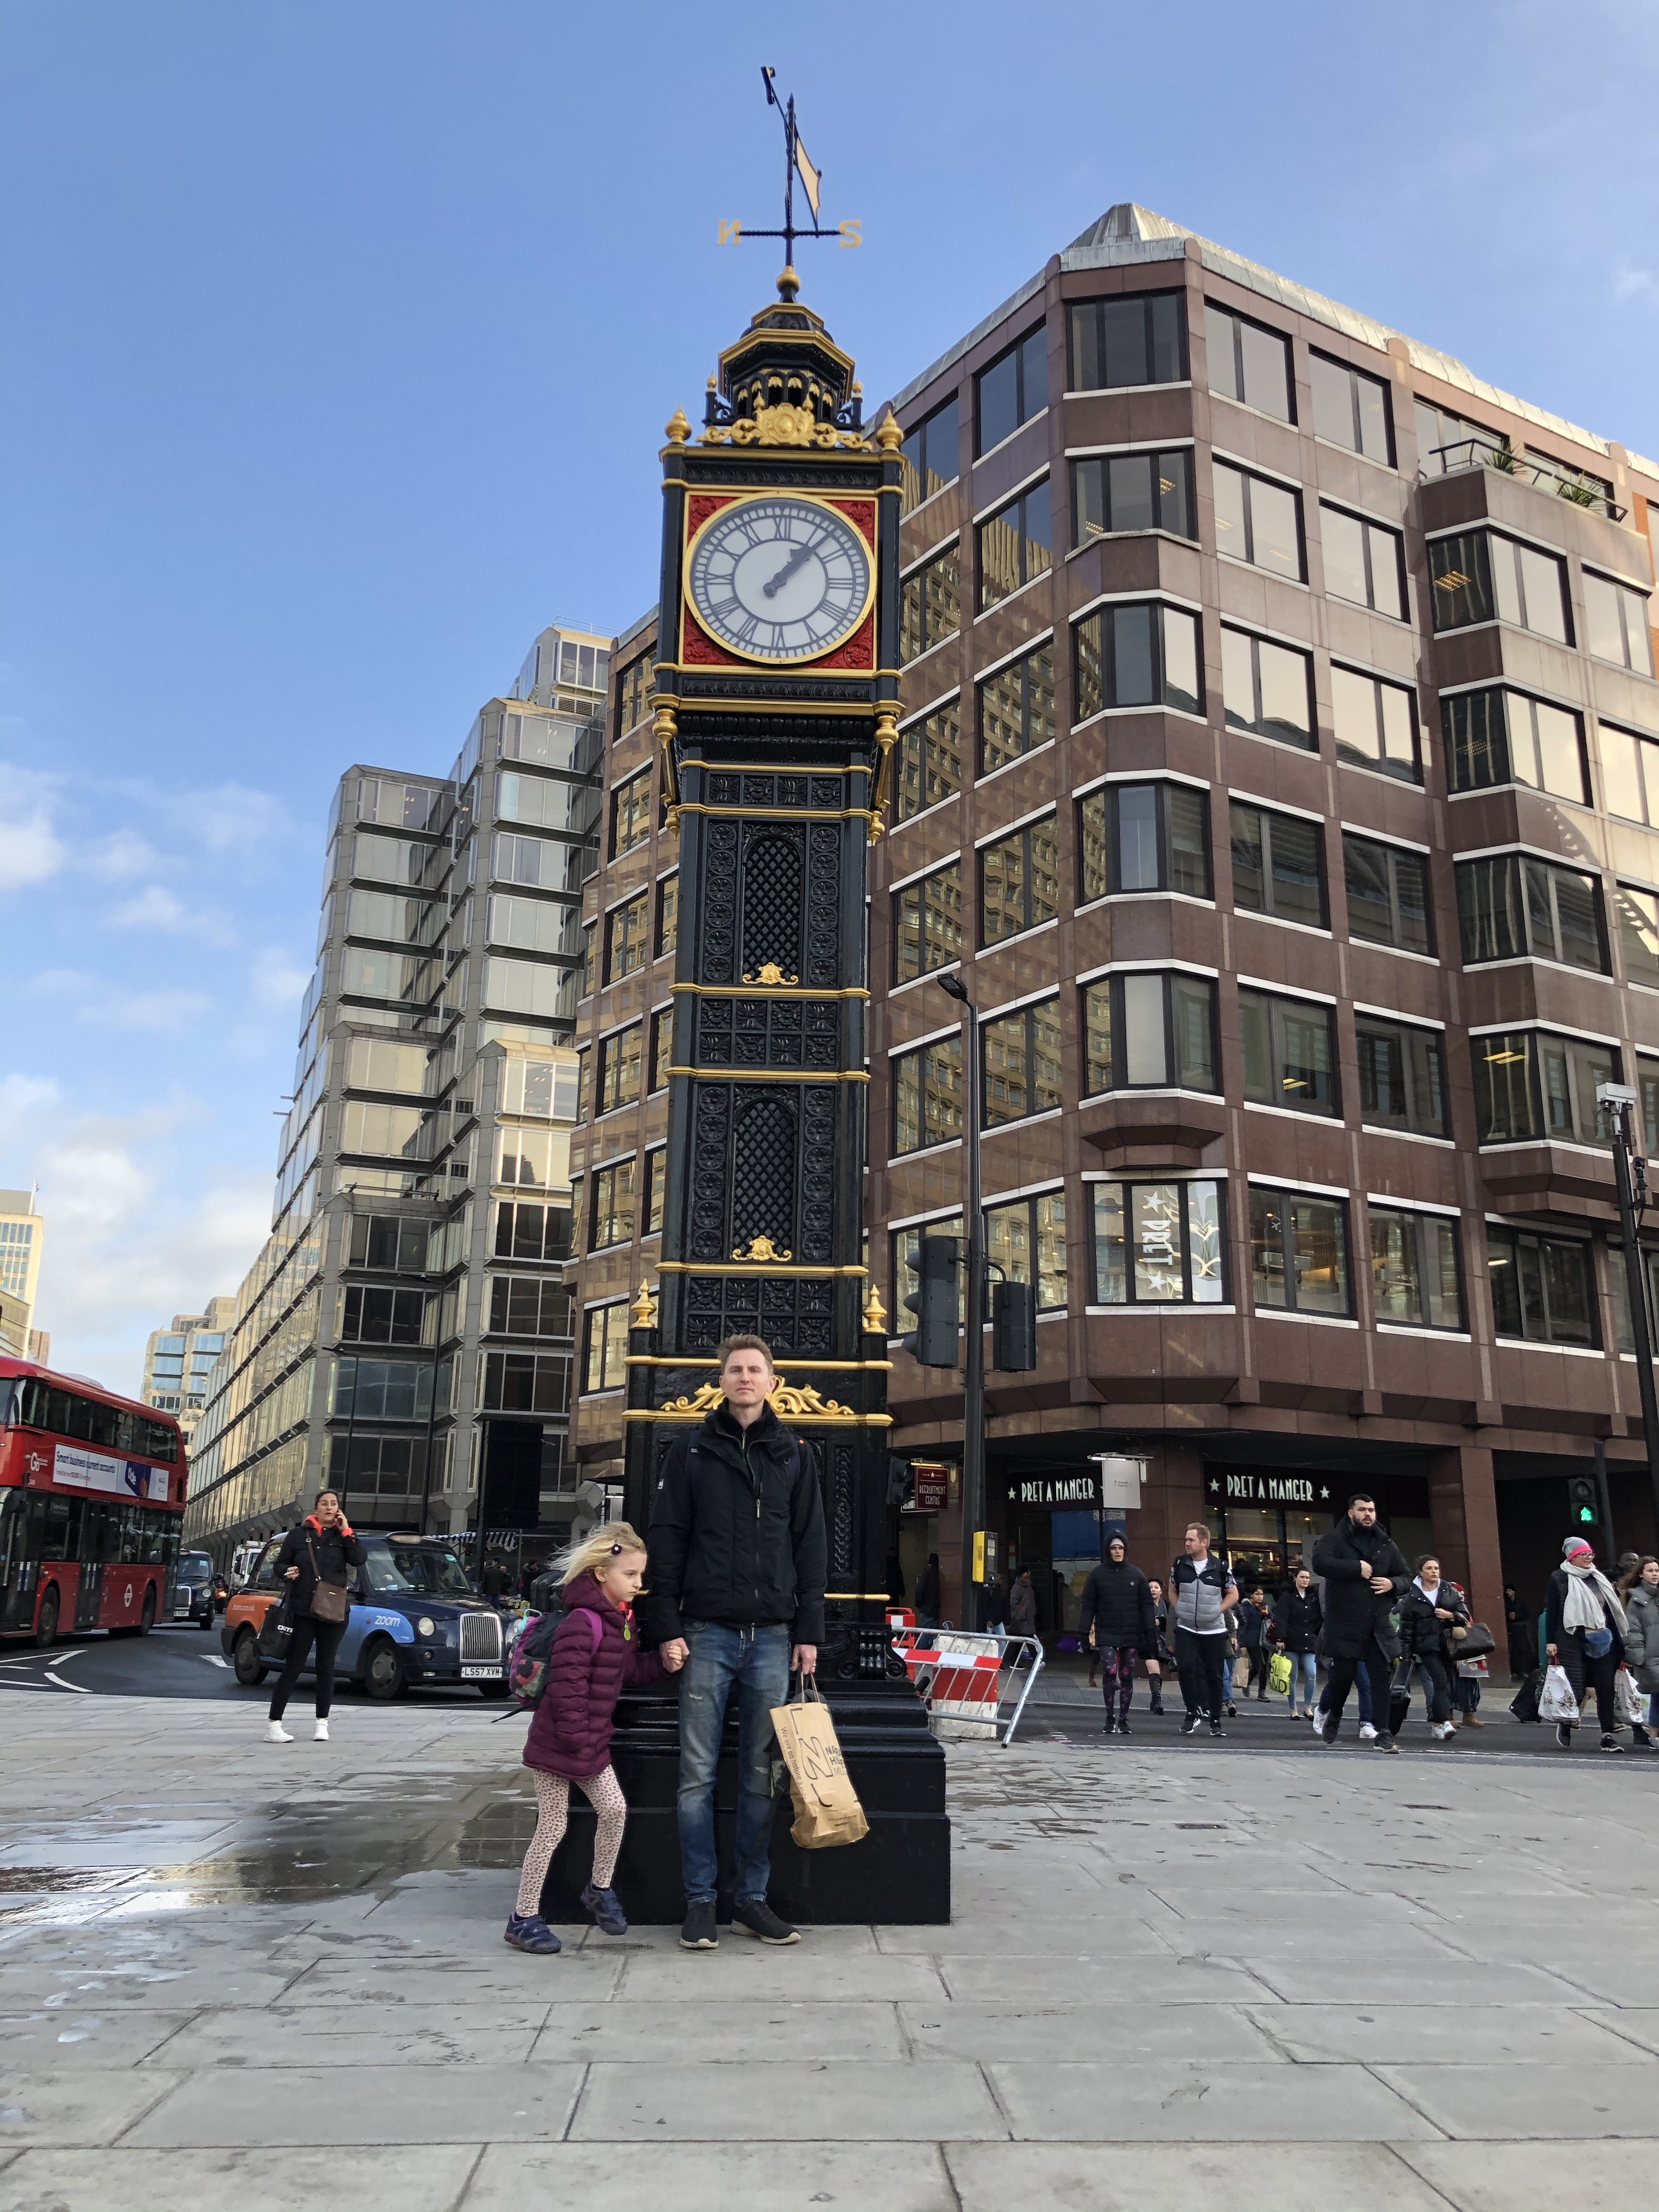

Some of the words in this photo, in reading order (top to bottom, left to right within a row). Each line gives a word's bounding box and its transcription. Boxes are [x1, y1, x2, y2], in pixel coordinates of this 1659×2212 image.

[838, 221, 861, 248] S
[738, 523, 762, 548] XI
[774, 517, 791, 540] XII
[716, 544, 741, 561] X
[821, 548, 845, 563] II
[707, 572, 732, 585] IX
[828, 578, 853, 589] III
[771, 625, 785, 648] VI
[1141, 1220, 1172, 1266] PRET
[128, 1467, 136, 1485] tide
[919, 1485, 946, 1494] RECRUITMENT
[1022, 1481, 1043, 1502] PRET
[1046, 1481, 1052, 1502] A
[1056, 1478, 1094, 1502] MANGER
[1227, 1475, 1254, 1498] PRET
[1258, 1477, 1265, 1499] A
[1269, 1477, 1314, 1502] MANGER
[925, 1496, 940, 1505] CENTRE
[375, 1615, 400, 1627] zoom
[781, 1726, 788, 1738] We
[788, 1751, 794, 1759] on
